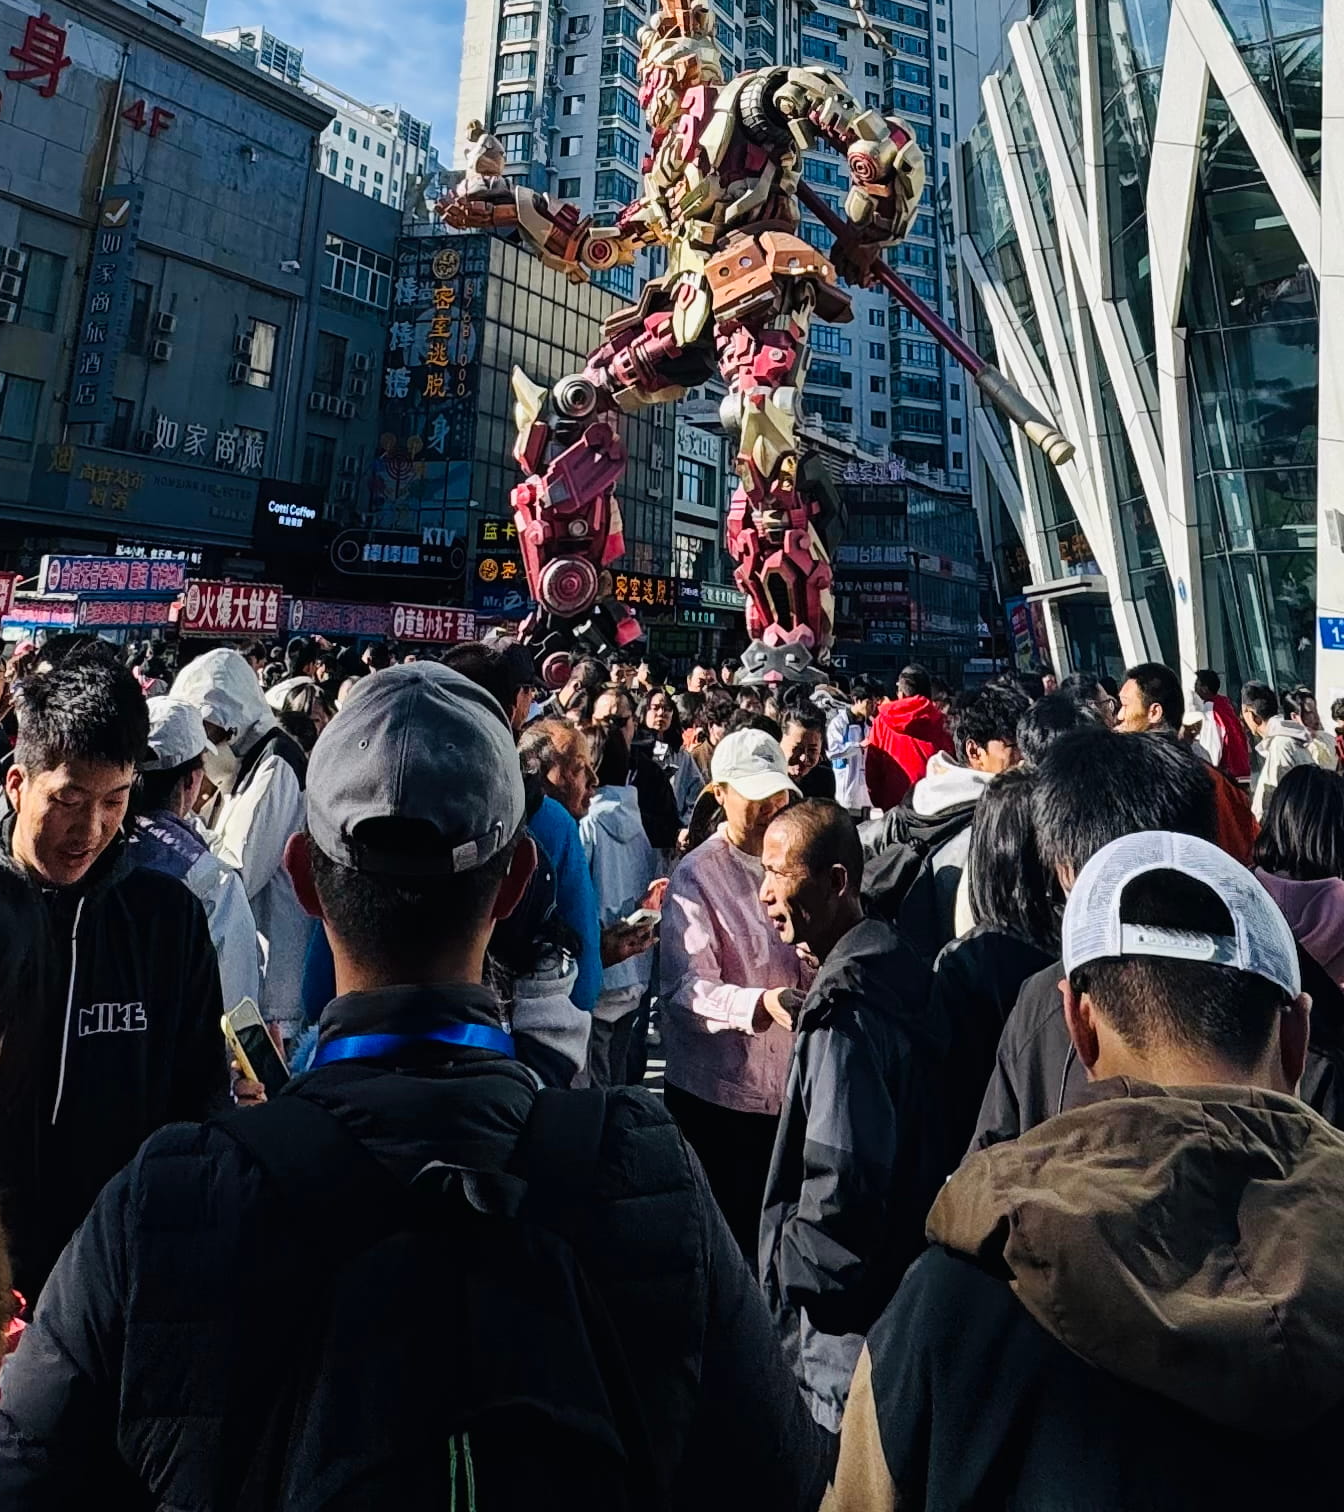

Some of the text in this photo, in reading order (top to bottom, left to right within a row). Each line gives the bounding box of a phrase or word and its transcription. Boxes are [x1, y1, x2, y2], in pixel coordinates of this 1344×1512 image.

[120, 99, 176, 139] 4F
[75, 232, 122, 406] 如家商旅酒店
[422, 285, 456, 398] 密室逃脱
[153, 414, 264, 475] 如家商旅
[422, 526, 457, 547] KTV
[197, 583, 278, 631] 火爆大鱿鱼
[404, 602, 455, 641] 章鱼小丸子
[78, 1002, 148, 1037] NIKE
